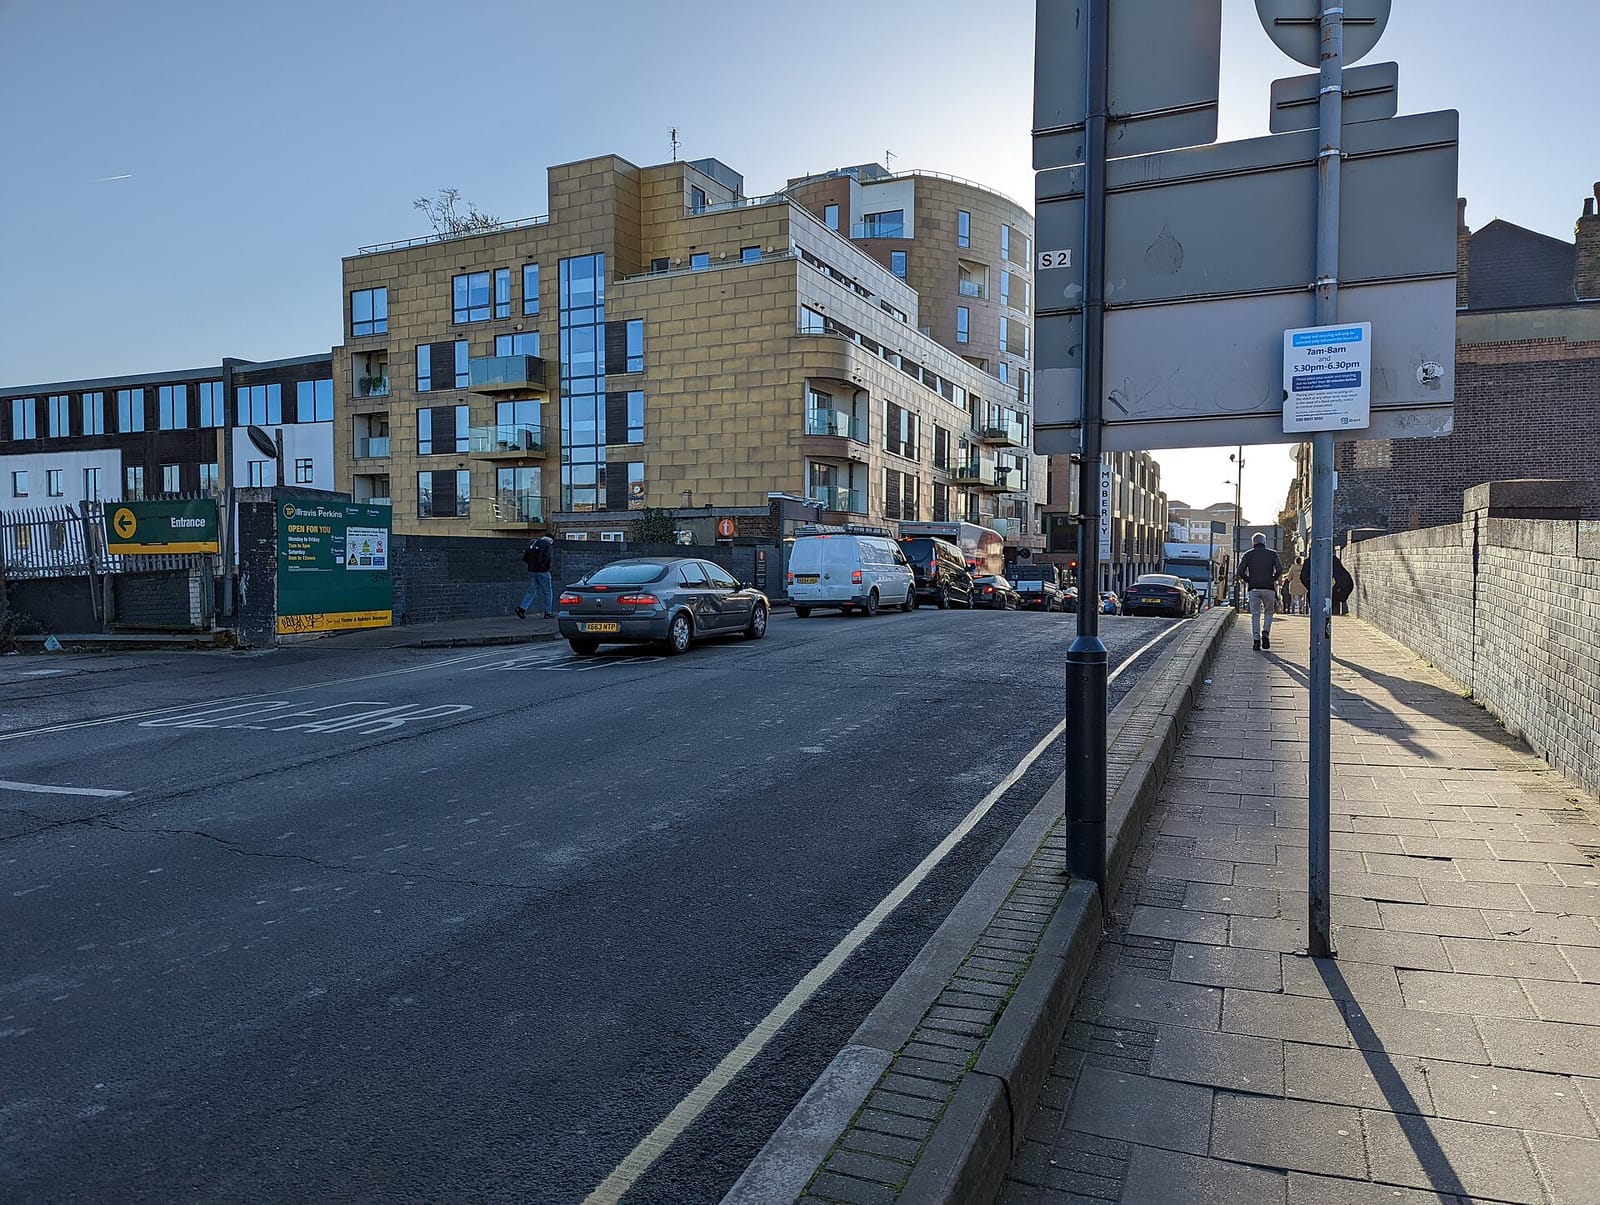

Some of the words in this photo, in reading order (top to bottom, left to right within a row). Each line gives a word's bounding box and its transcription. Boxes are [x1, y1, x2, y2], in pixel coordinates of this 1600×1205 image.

[1306, 346, 1346, 356] 7am-8am
[1294, 361, 1360, 373] 5.30pm-6.30pm
[1101, 472, 1109, 535] MOBERLY
[318, 509, 343, 518] Perkins
[171, 517, 206, 528] Entrance
[288, 525, 305, 533] OPEN
[306, 525, 318, 533] FOR
[319, 525, 331, 534] YOU
[138, 700, 474, 734] CLEAR
